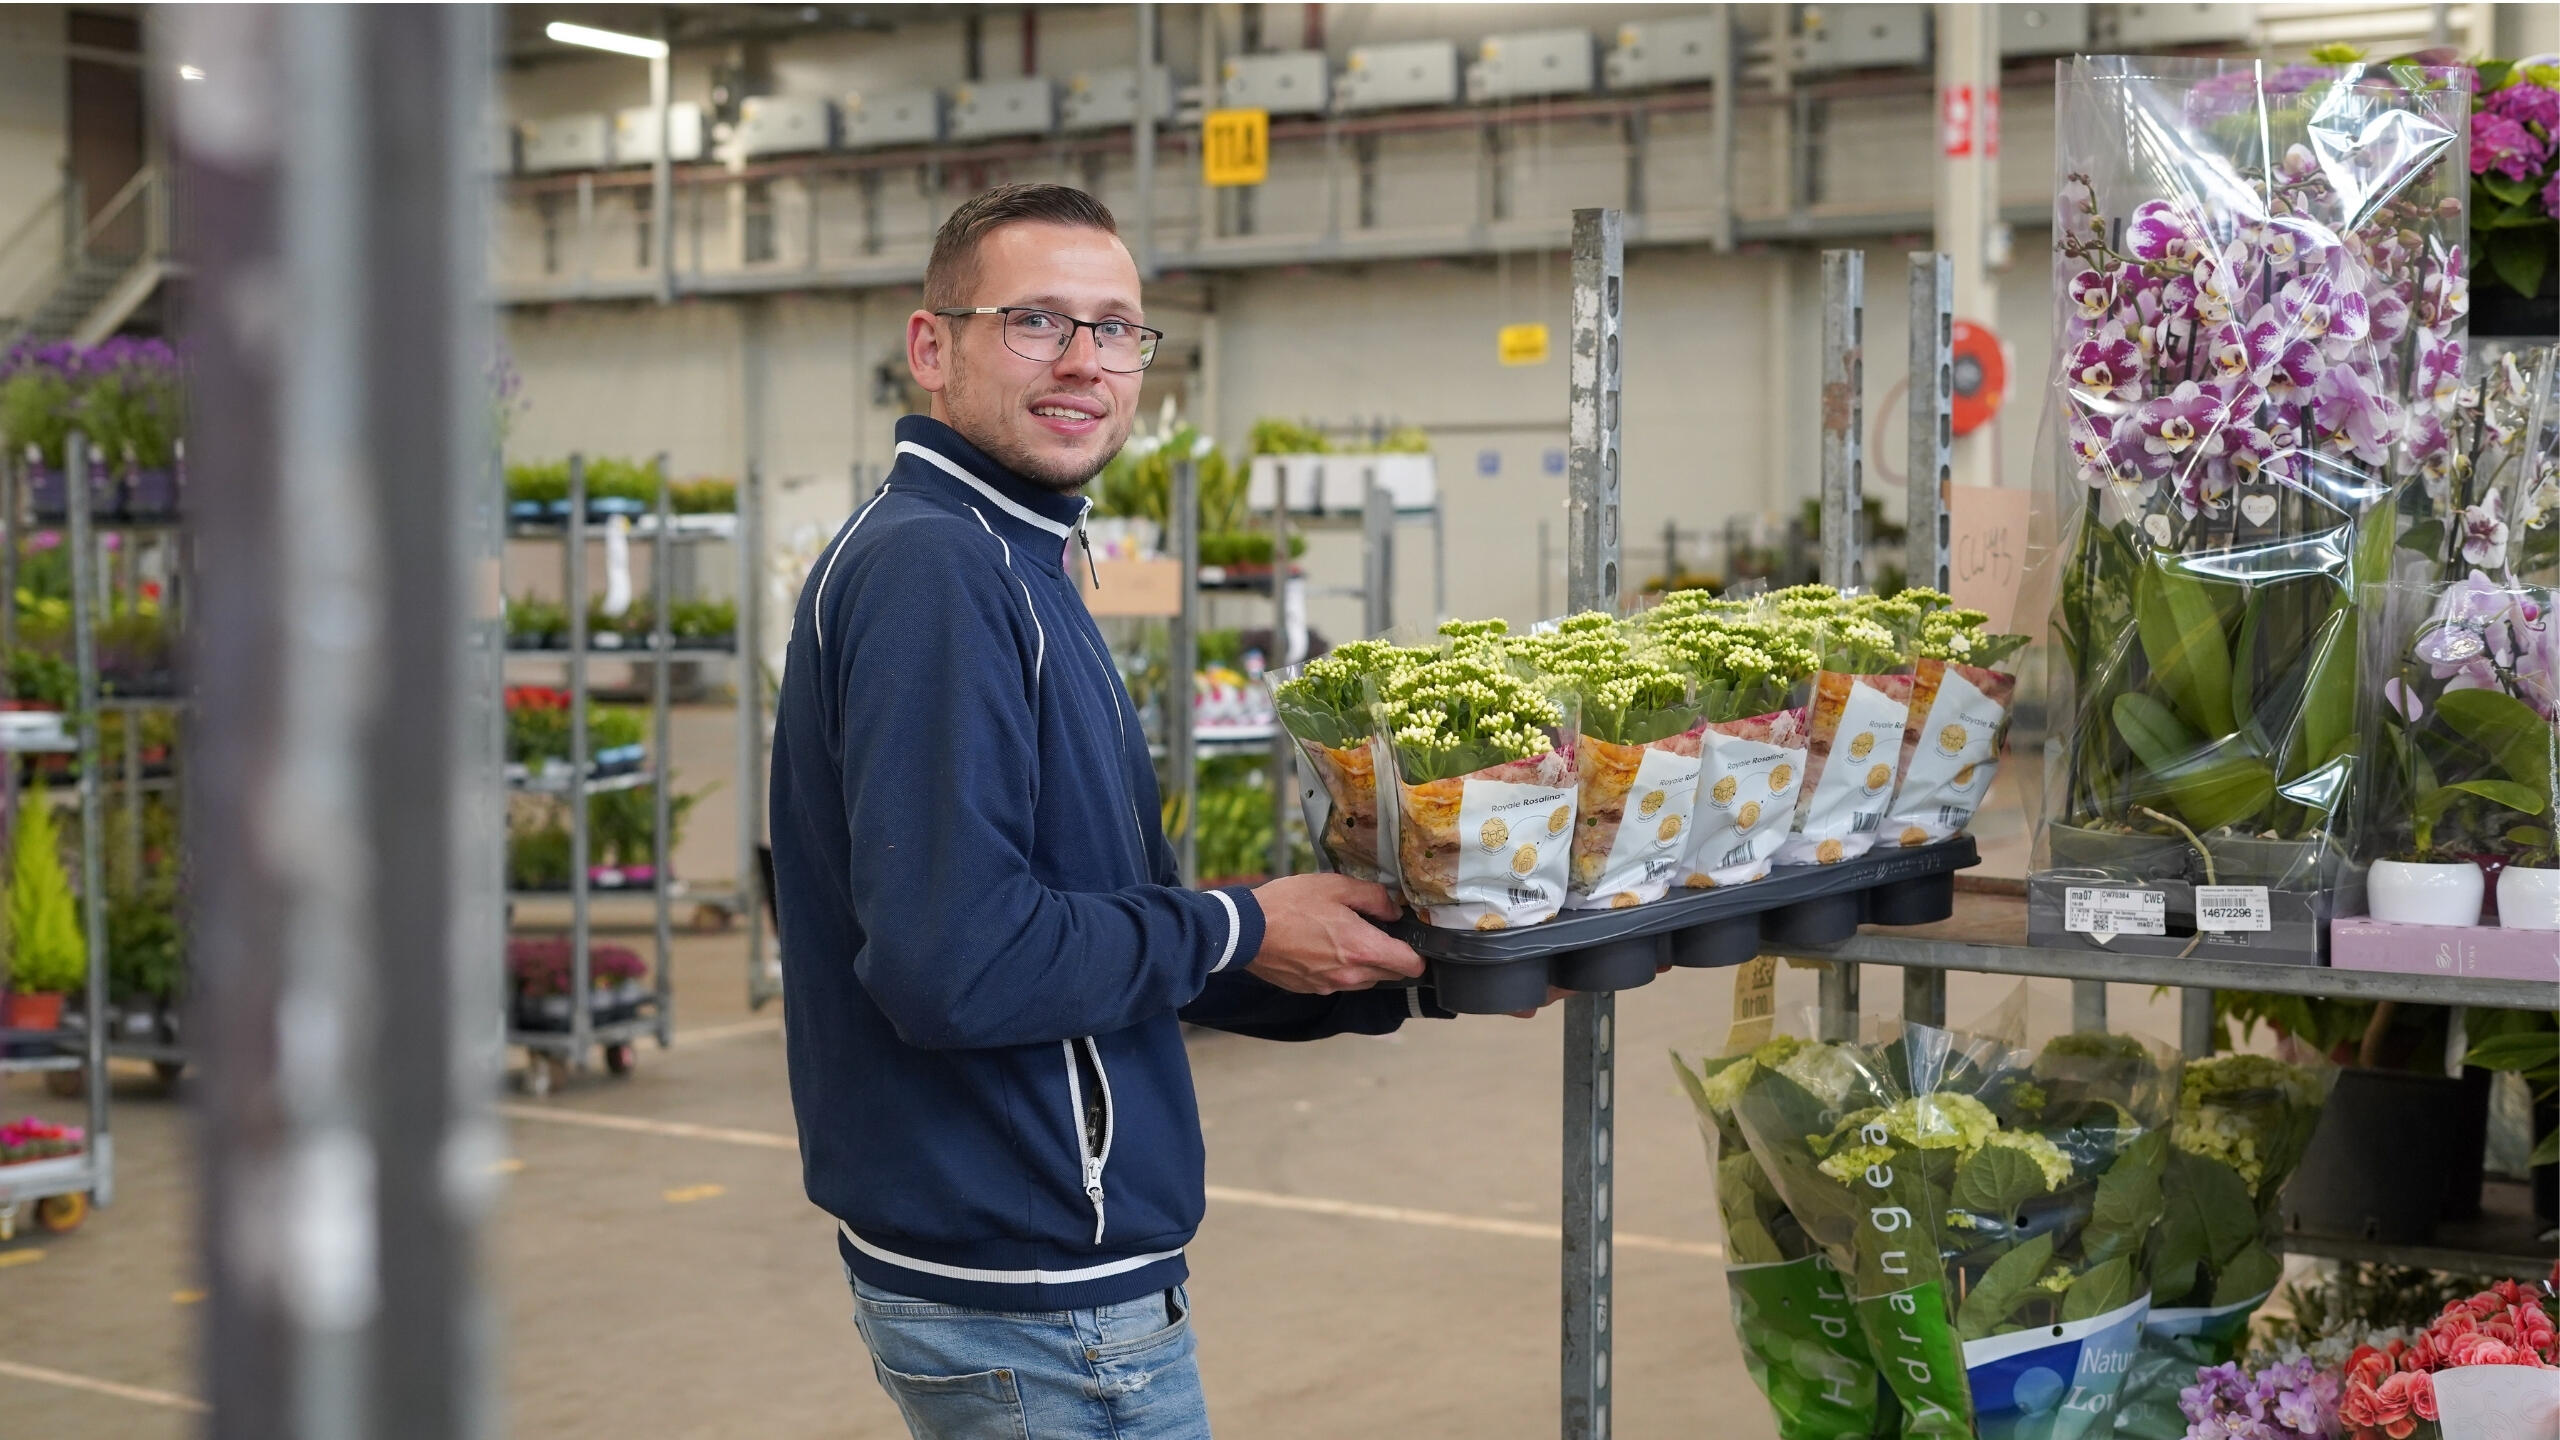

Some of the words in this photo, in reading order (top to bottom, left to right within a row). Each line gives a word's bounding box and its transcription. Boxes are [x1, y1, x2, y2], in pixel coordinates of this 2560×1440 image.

[1213, 122, 1259, 169] 11A
[1868, 719, 1894, 729] Royale
[1959, 712, 1987, 728] Royale
[1727, 760, 1751, 770] Royale
[1659, 776, 1684, 786] Royale
[1491, 801, 1521, 813] Royale
[2071, 890, 2092, 901] ma07
[2202, 908, 2252, 918] 14672296
[1861, 1123, 1950, 1440] ydrangea
